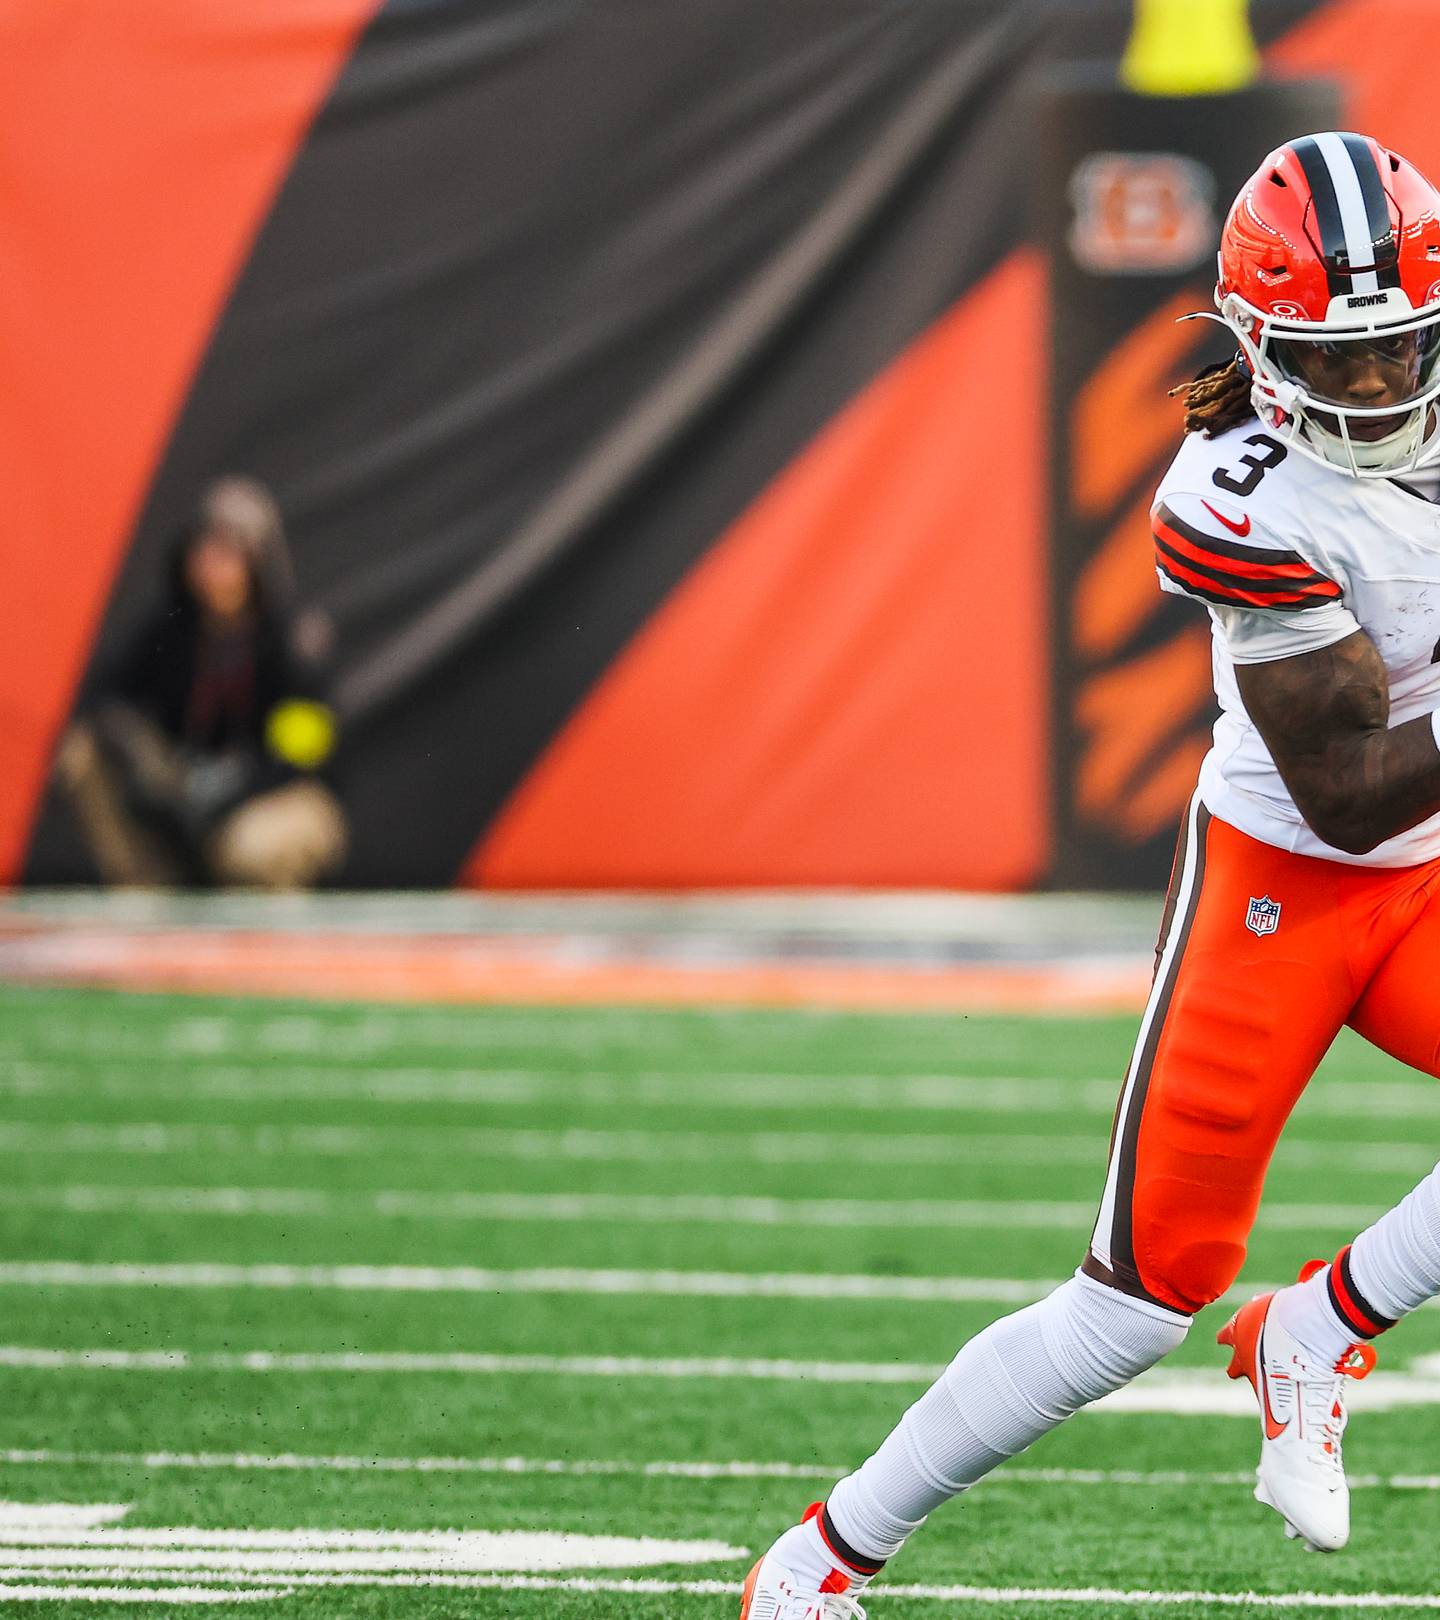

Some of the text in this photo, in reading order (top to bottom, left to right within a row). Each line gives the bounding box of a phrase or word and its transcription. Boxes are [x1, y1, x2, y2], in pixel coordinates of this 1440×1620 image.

[1347, 293, 1388, 308] BROWNS
[1212, 434, 1287, 496] 3
[1251, 912, 1275, 929] NFL
